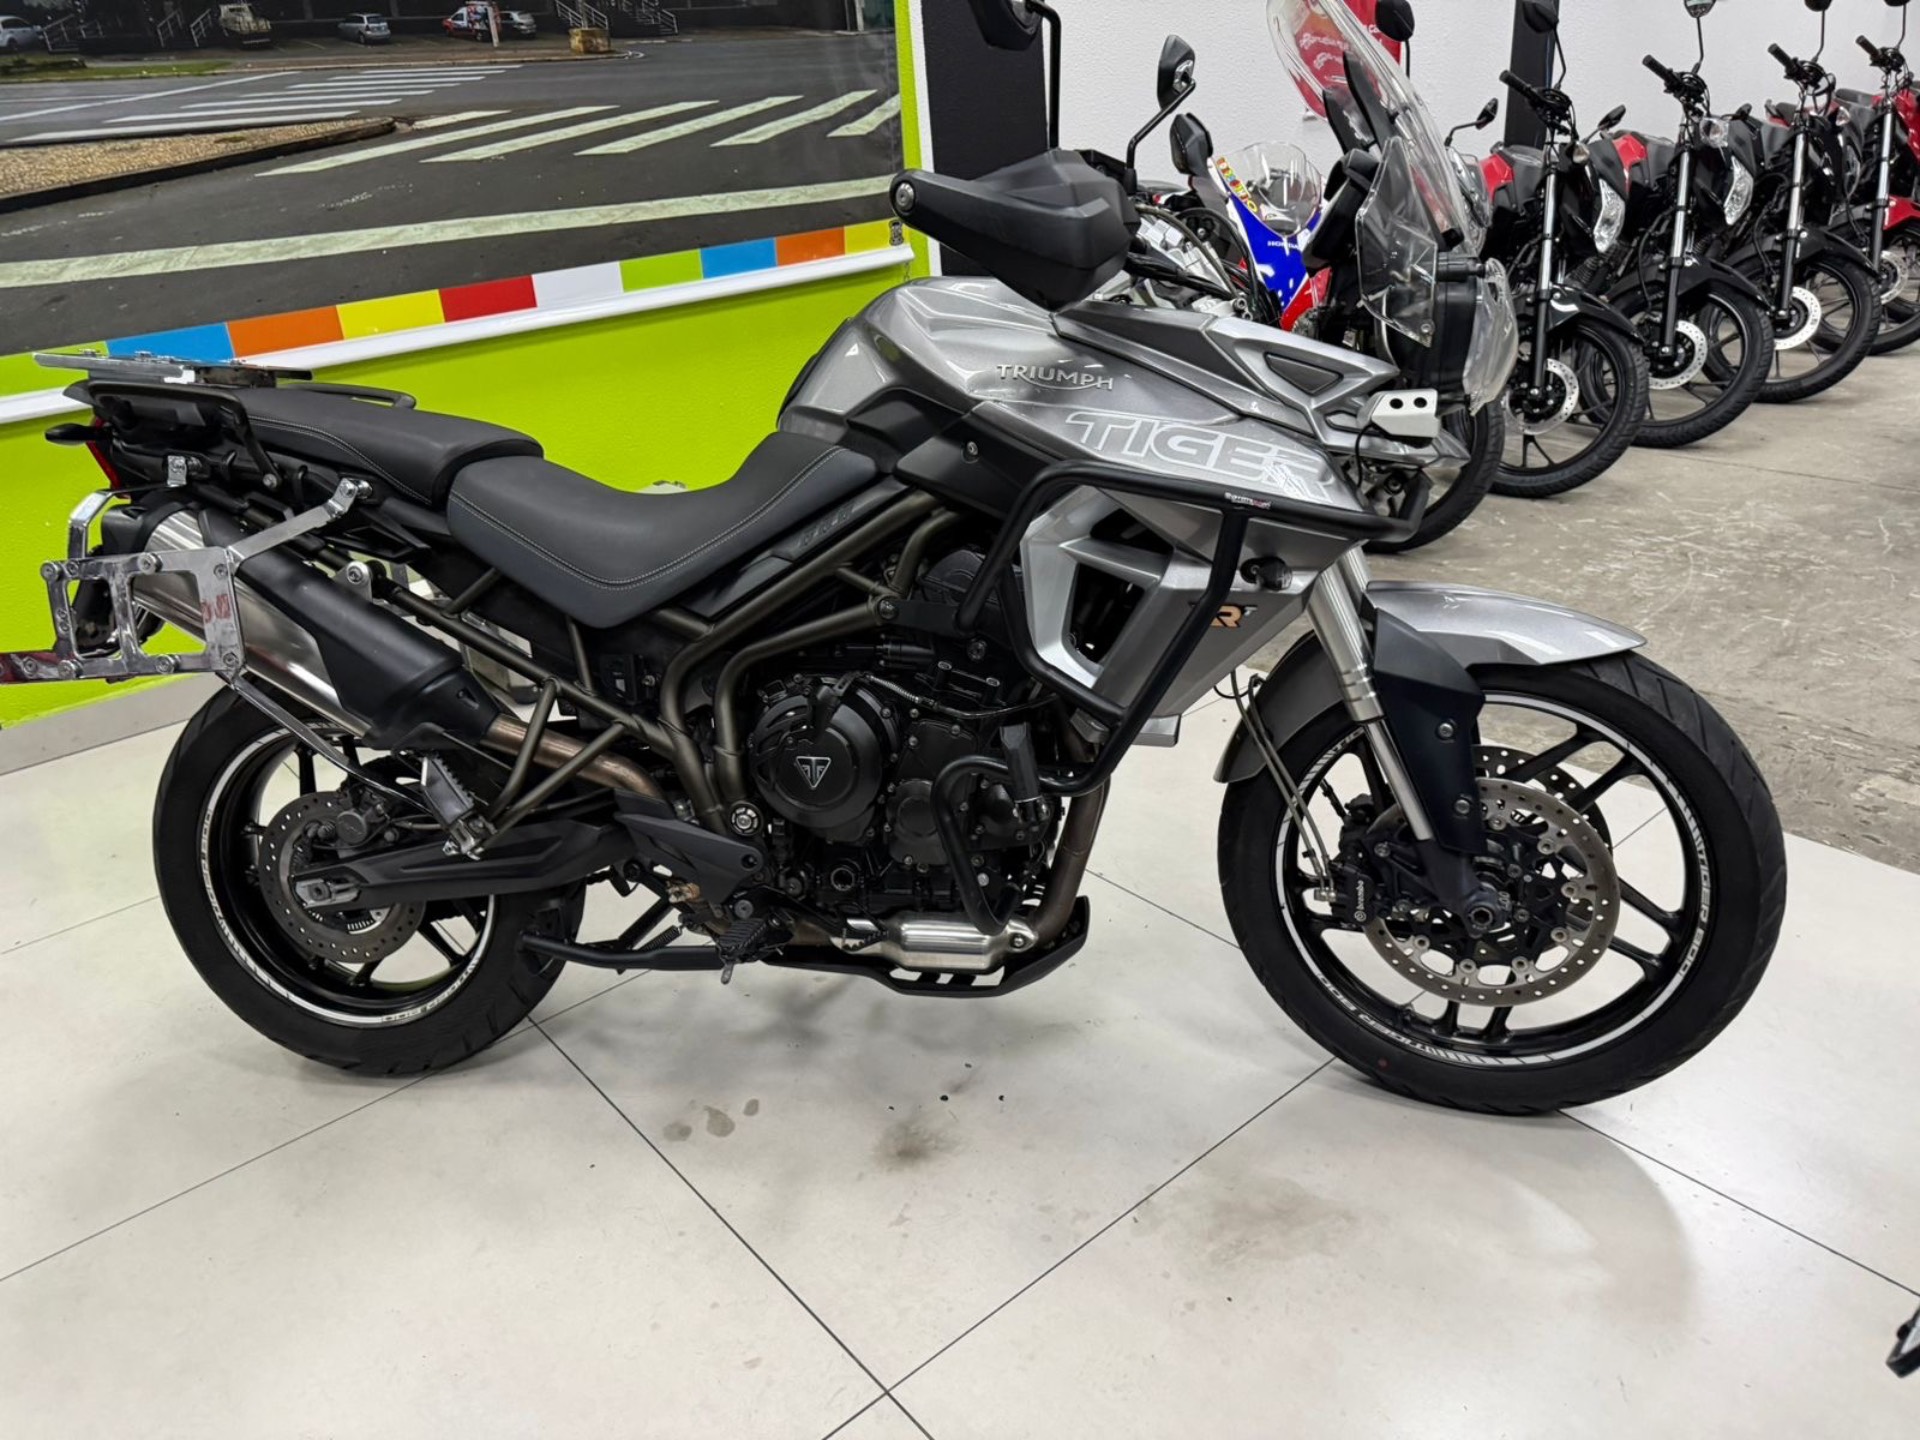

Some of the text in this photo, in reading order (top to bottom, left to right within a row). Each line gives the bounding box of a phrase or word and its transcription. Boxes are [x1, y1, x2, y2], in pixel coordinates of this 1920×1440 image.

[996, 364, 1114, 391] TRIUMPH
[1065, 411, 1336, 504] TIGER
[1355, 879, 1365, 910] brembo
[1677, 848, 1712, 975] TIGER 800
[1319, 976, 1426, 1050] TIGER 800
